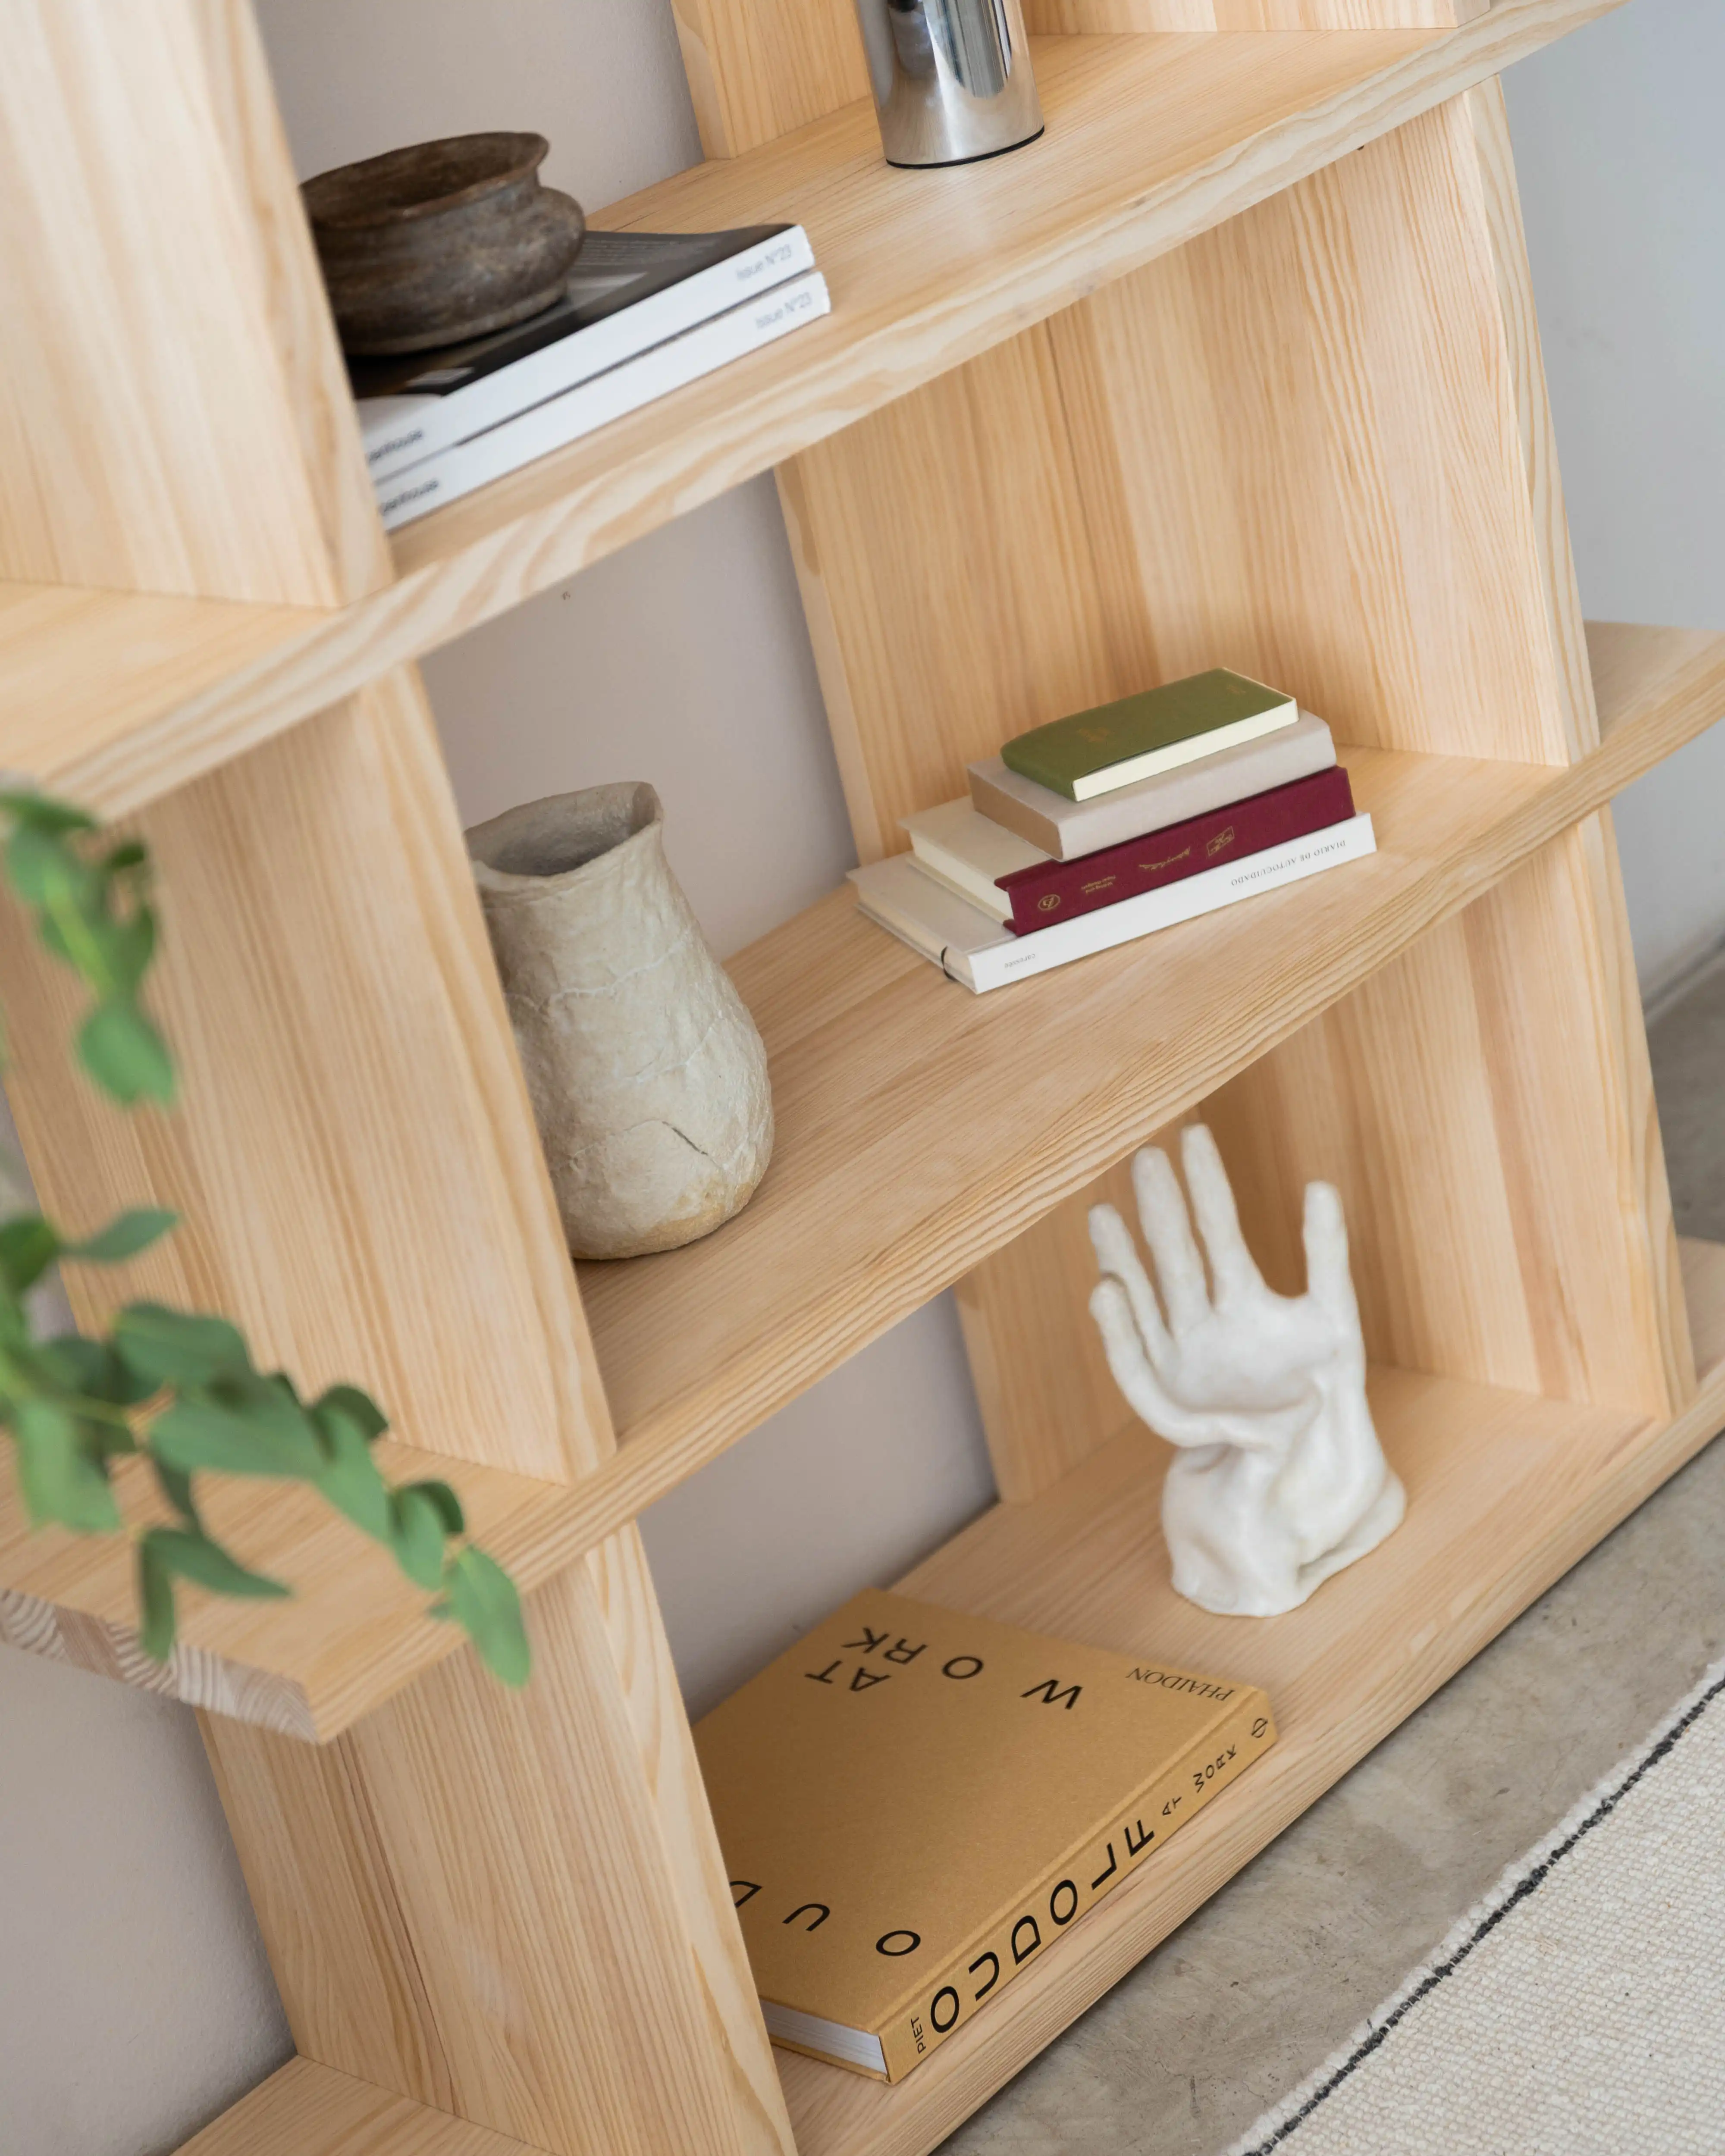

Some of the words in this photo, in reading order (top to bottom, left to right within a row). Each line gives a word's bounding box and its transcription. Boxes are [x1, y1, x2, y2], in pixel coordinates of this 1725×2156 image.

[1300, 852, 1311, 862] DE
[1314, 840, 1346, 856] DIARIO
[1231, 857, 1297, 886] AUTOCUIDADO
[804, 1660, 892, 1692] AT
[1125, 1667, 1235, 1702] PHAIDON
[910, 2016, 926, 2055] PIET
[930, 1819, 1155, 2034] OUDOLF
[1162, 1796, 1182, 1816] AT
[1193, 1743, 1237, 1793] WORK
